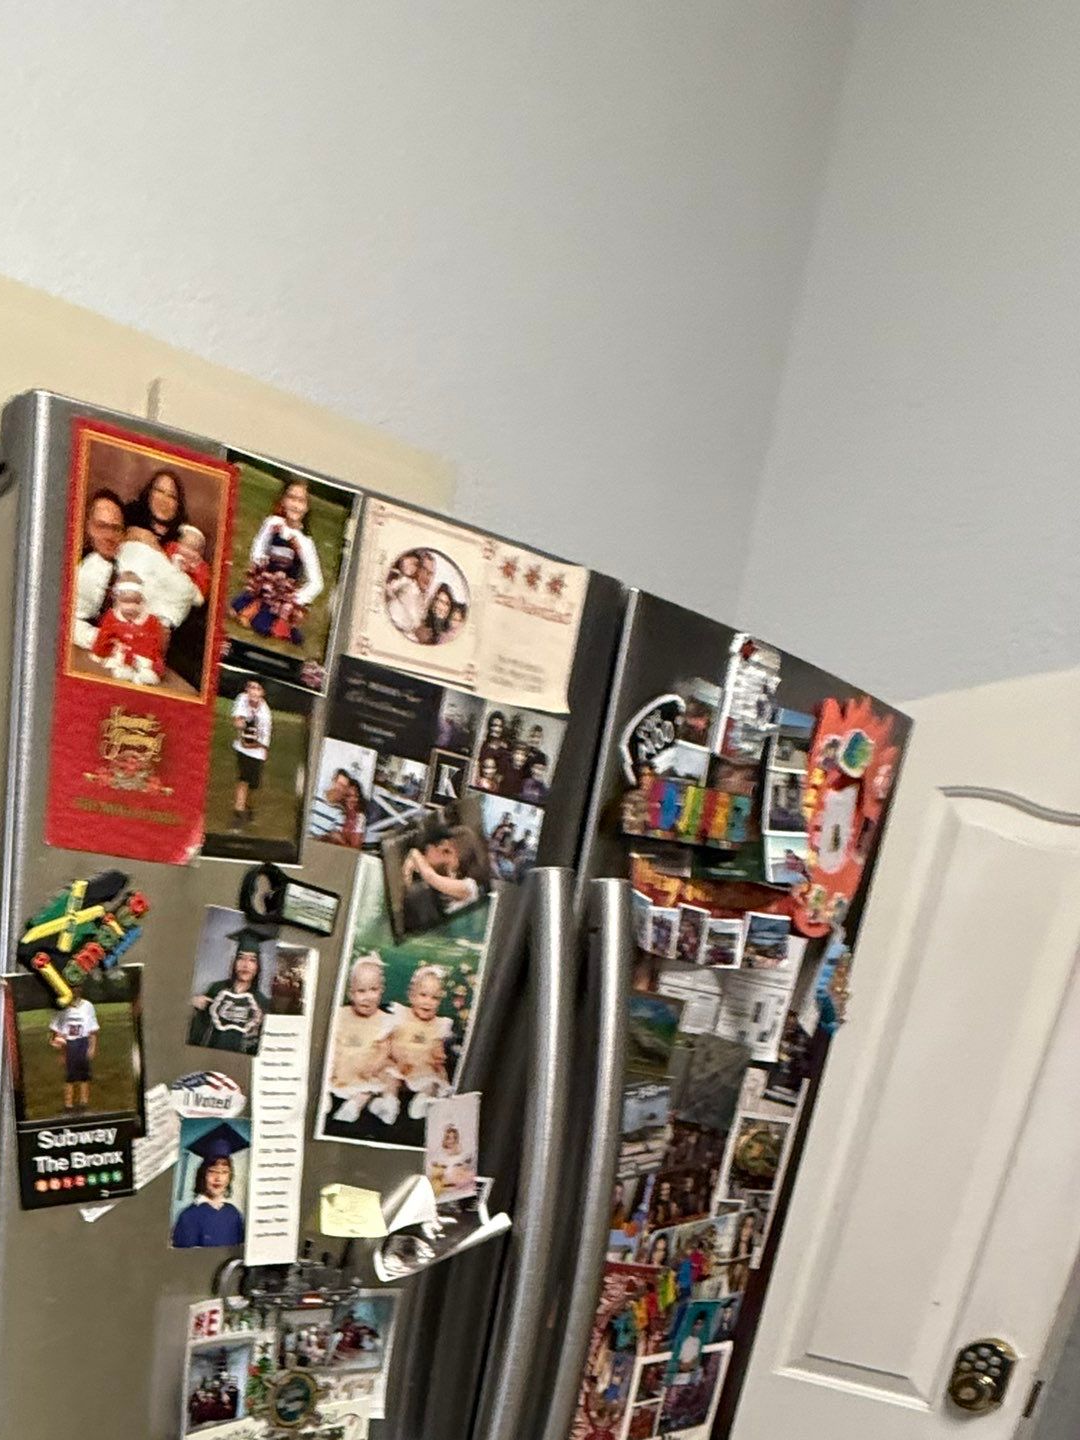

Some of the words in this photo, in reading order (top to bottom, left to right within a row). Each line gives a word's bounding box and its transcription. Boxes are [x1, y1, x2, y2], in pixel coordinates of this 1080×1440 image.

[194, 1092, 233, 1110] Voted
[37, 1127, 118, 1150] Subway
[32, 1155, 70, 1174] The
[70, 1151, 124, 1170] Bronx
